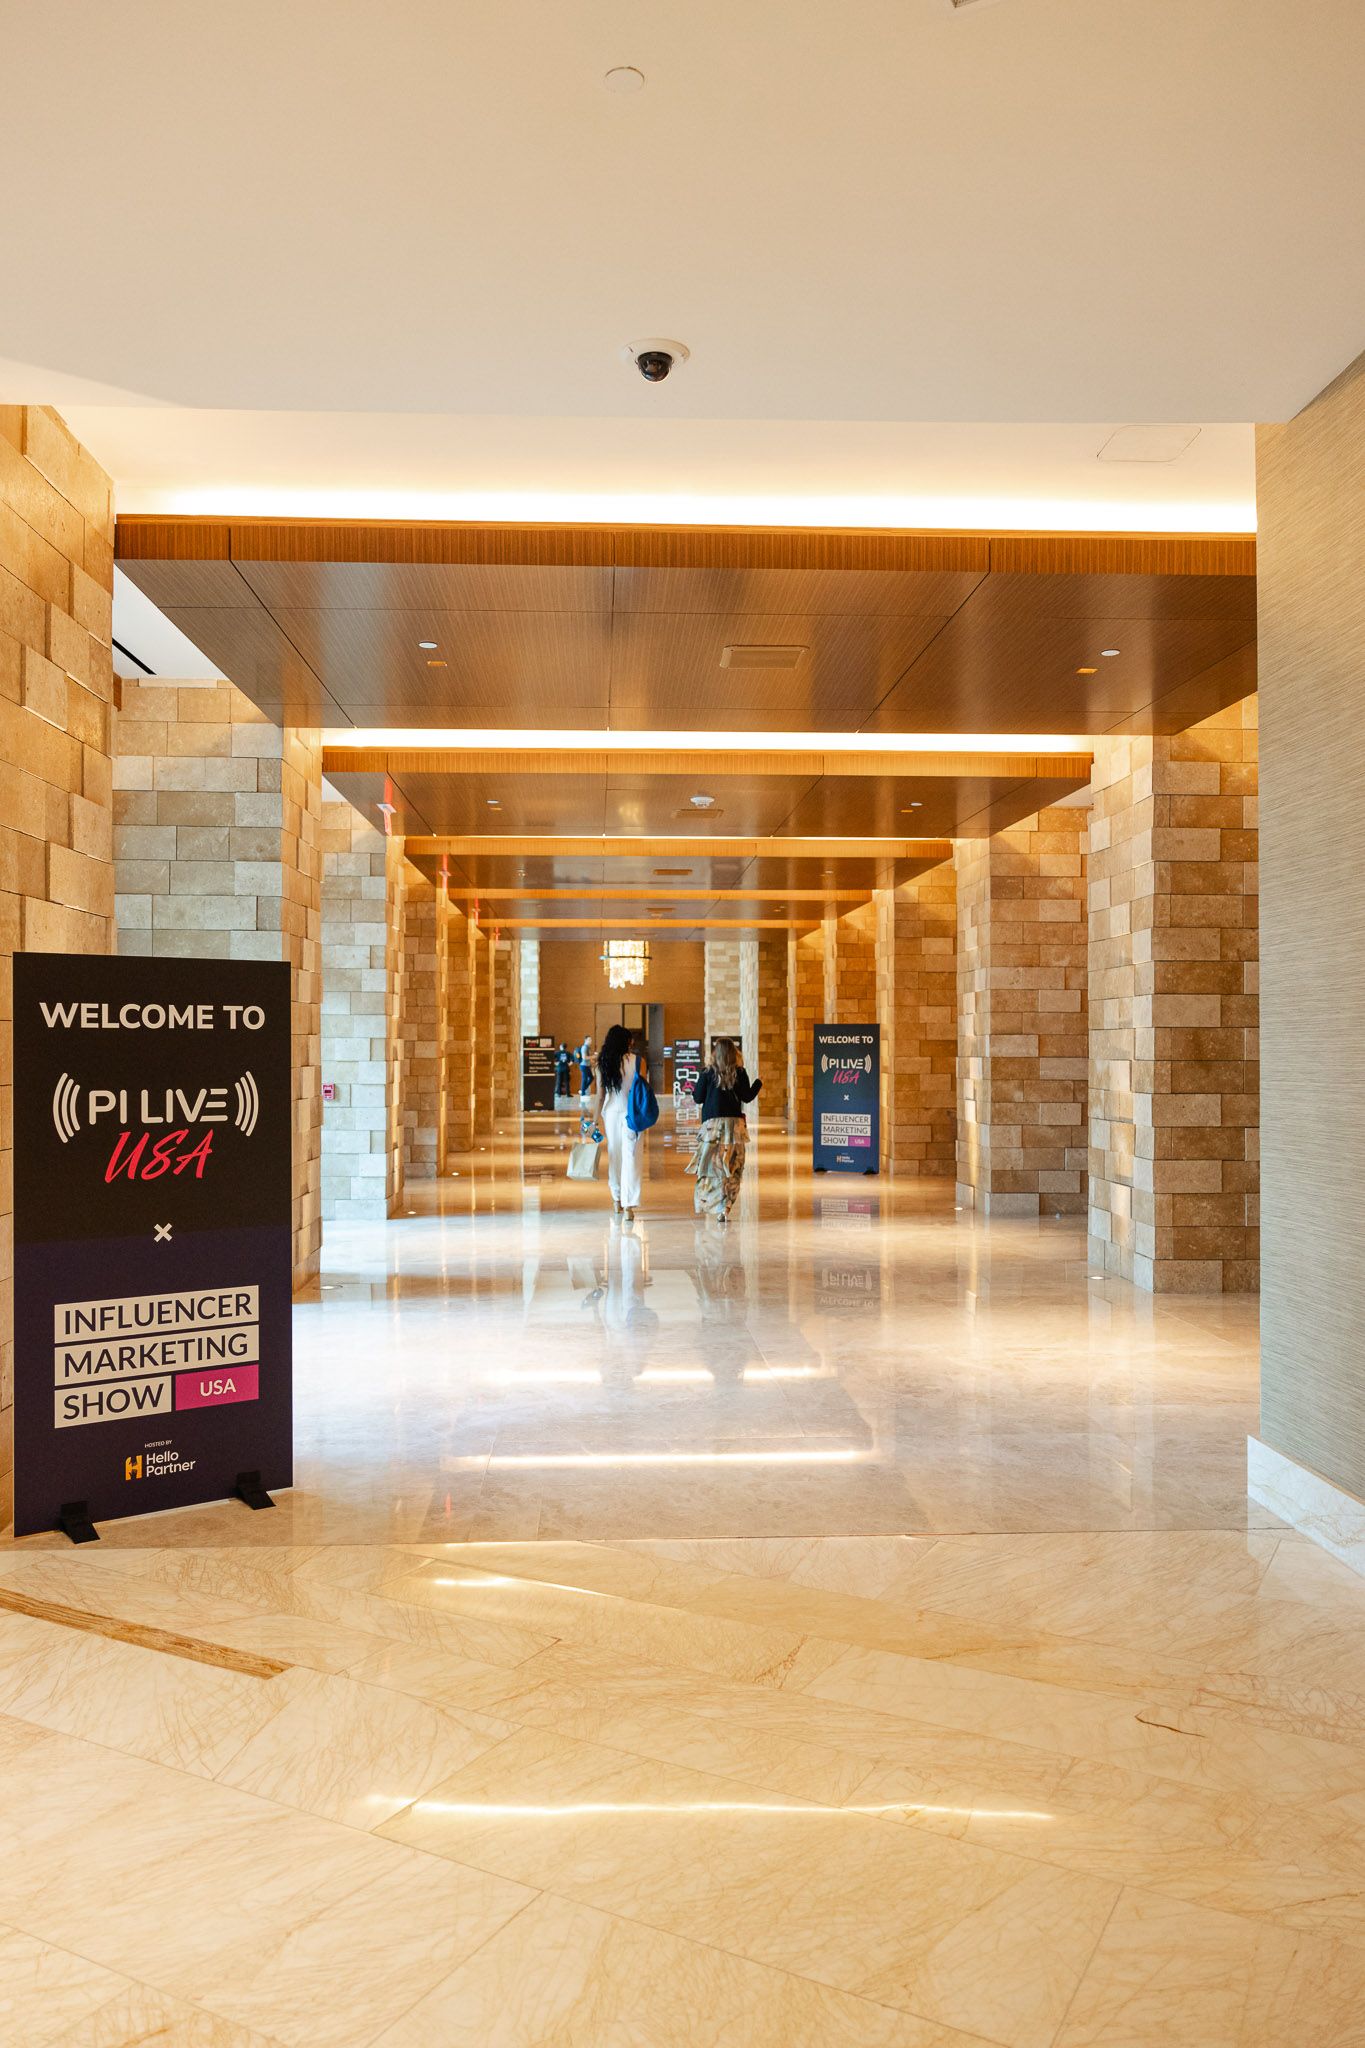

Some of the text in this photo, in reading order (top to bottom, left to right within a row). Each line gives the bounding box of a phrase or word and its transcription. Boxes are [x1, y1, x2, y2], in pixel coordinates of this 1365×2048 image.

[39, 1002, 265, 1030] WELCOME TO
[819, 1035, 874, 1044] WELCOME TO
[829, 1058, 864, 1069] PI LIVE
[832, 1070, 860, 1085] USA
[88, 1088, 228, 1125] PI LIVE
[823, 1115, 869, 1123] INFLUENCER
[823, 1126, 868, 1134] MARKETING
[822, 1136, 847, 1144] SHOW
[104, 1128, 214, 1184] USA
[64, 1293, 253, 1335] INFLUENCER
[64, 1333, 248, 1378] MARKETING
[62, 1378, 236, 1420] SHOW USA
[144, 1440, 165, 1448] HOSTED
[146, 1450, 179, 1465] Hello
[146, 1460, 196, 1478] Partner
